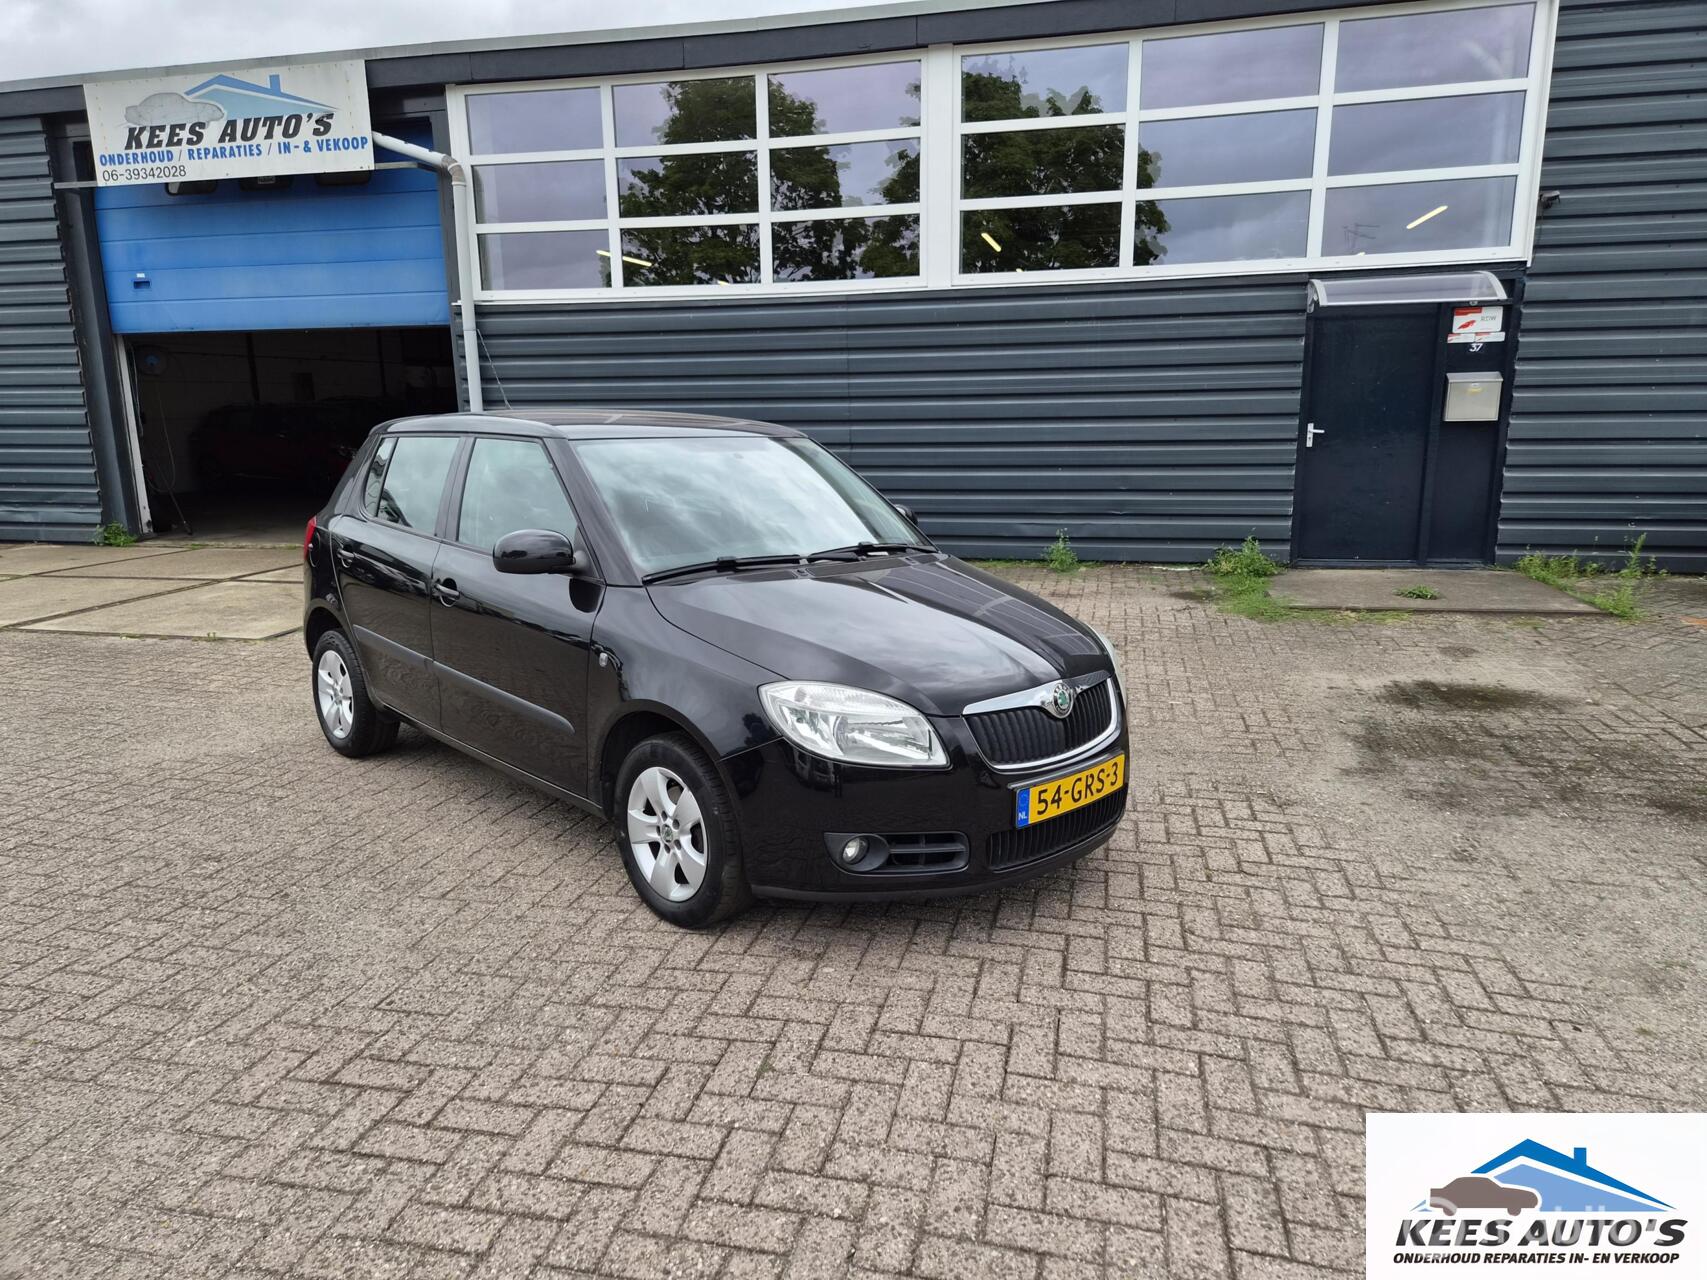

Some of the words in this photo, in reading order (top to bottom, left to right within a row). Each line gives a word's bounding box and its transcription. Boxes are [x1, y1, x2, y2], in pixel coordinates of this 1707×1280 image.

[124, 121, 207, 150] KEES
[217, 112, 335, 144] AUTO'S
[99, 149, 174, 166] ONDERHOUD
[187, 143, 262, 160] REPARATIES
[316, 136, 368, 152] VEKOOP
[102, 165, 187, 181] 06-39342028
[1469, 343, 1483, 352] 37
[1037, 761, 1118, 816] 54-GRS-3
[1018, 811, 1027, 820] NL
